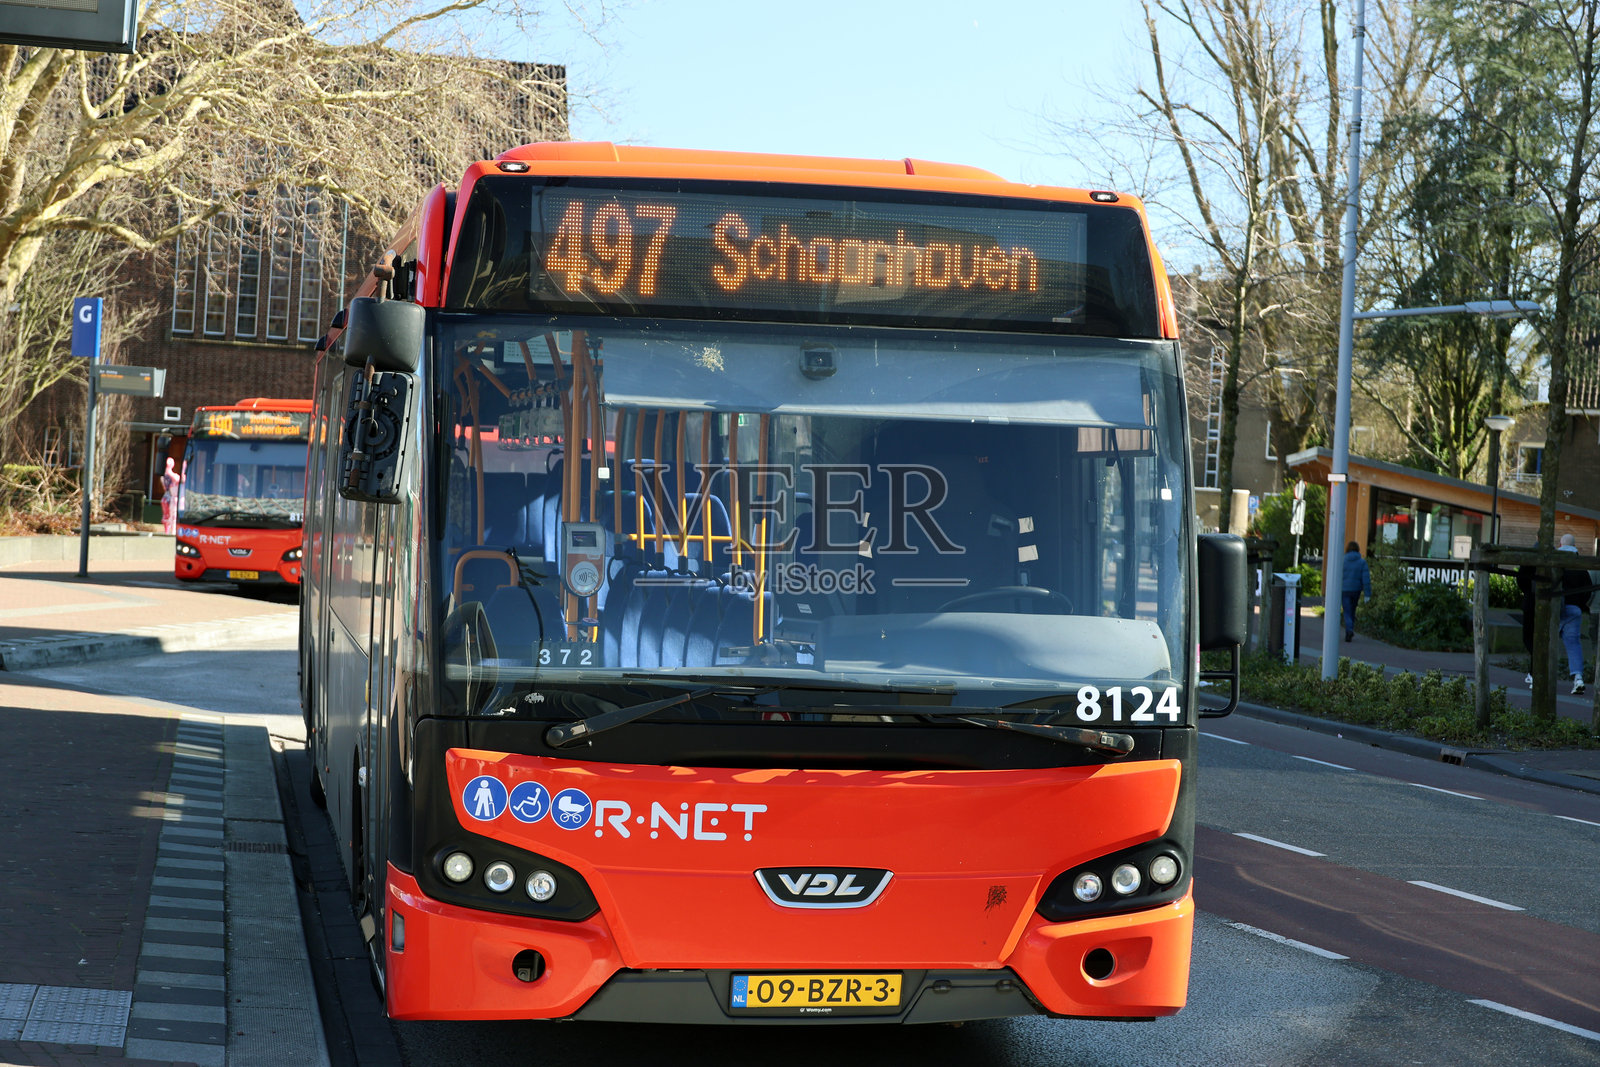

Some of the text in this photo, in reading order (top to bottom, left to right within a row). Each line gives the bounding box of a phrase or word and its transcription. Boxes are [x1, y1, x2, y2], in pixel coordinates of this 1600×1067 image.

[545, 201, 1039, 295] 497 Schoonhoven
[79, 305, 92, 323] G
[208, 414, 233, 435] 190
[241, 425, 300, 435] via Moordrecht
[1076, 685, 1181, 721] 8124
[778, 873, 865, 896] VDL
[733, 994, 745, 1003] NL
